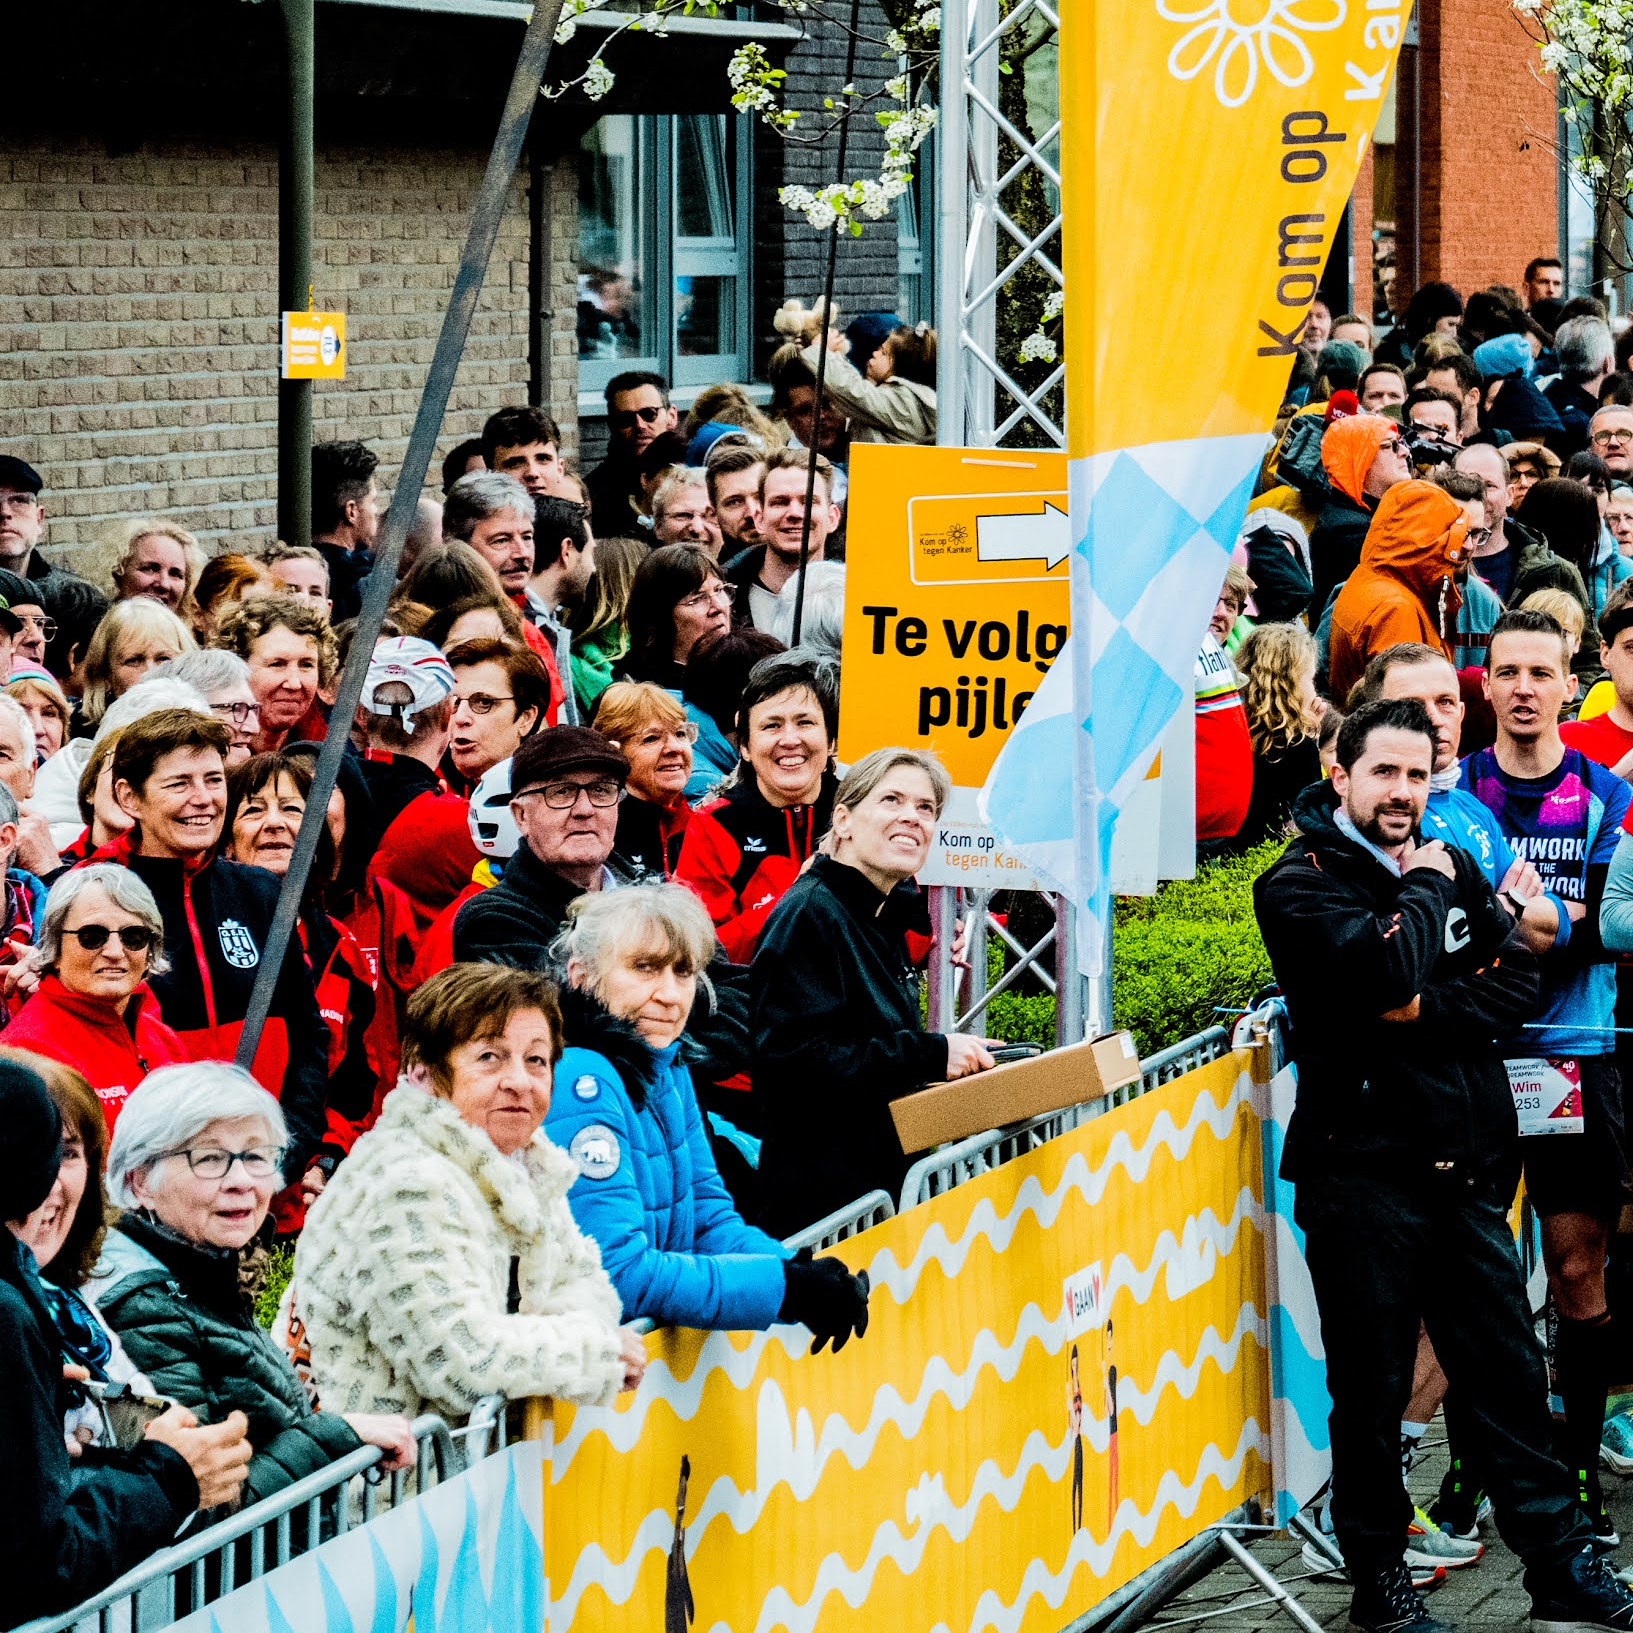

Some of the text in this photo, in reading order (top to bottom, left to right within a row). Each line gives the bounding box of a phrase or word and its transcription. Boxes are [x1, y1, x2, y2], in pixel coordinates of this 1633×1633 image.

[1257, 109, 1347, 358] Kom op
[919, 538, 947, 547] Kom op
[923, 546, 973, 557] tegen Kanker
[862, 606, 1068, 674] Te volg
[940, 830, 994, 853] Kom op
[945, 850, 988, 870] tegen
[1539, 863, 1556, 873] THE
[1562, 1060, 1575, 1070] 40
[1512, 1081, 1542, 1093] Wim
[1515, 1097, 1540, 1110] 253
